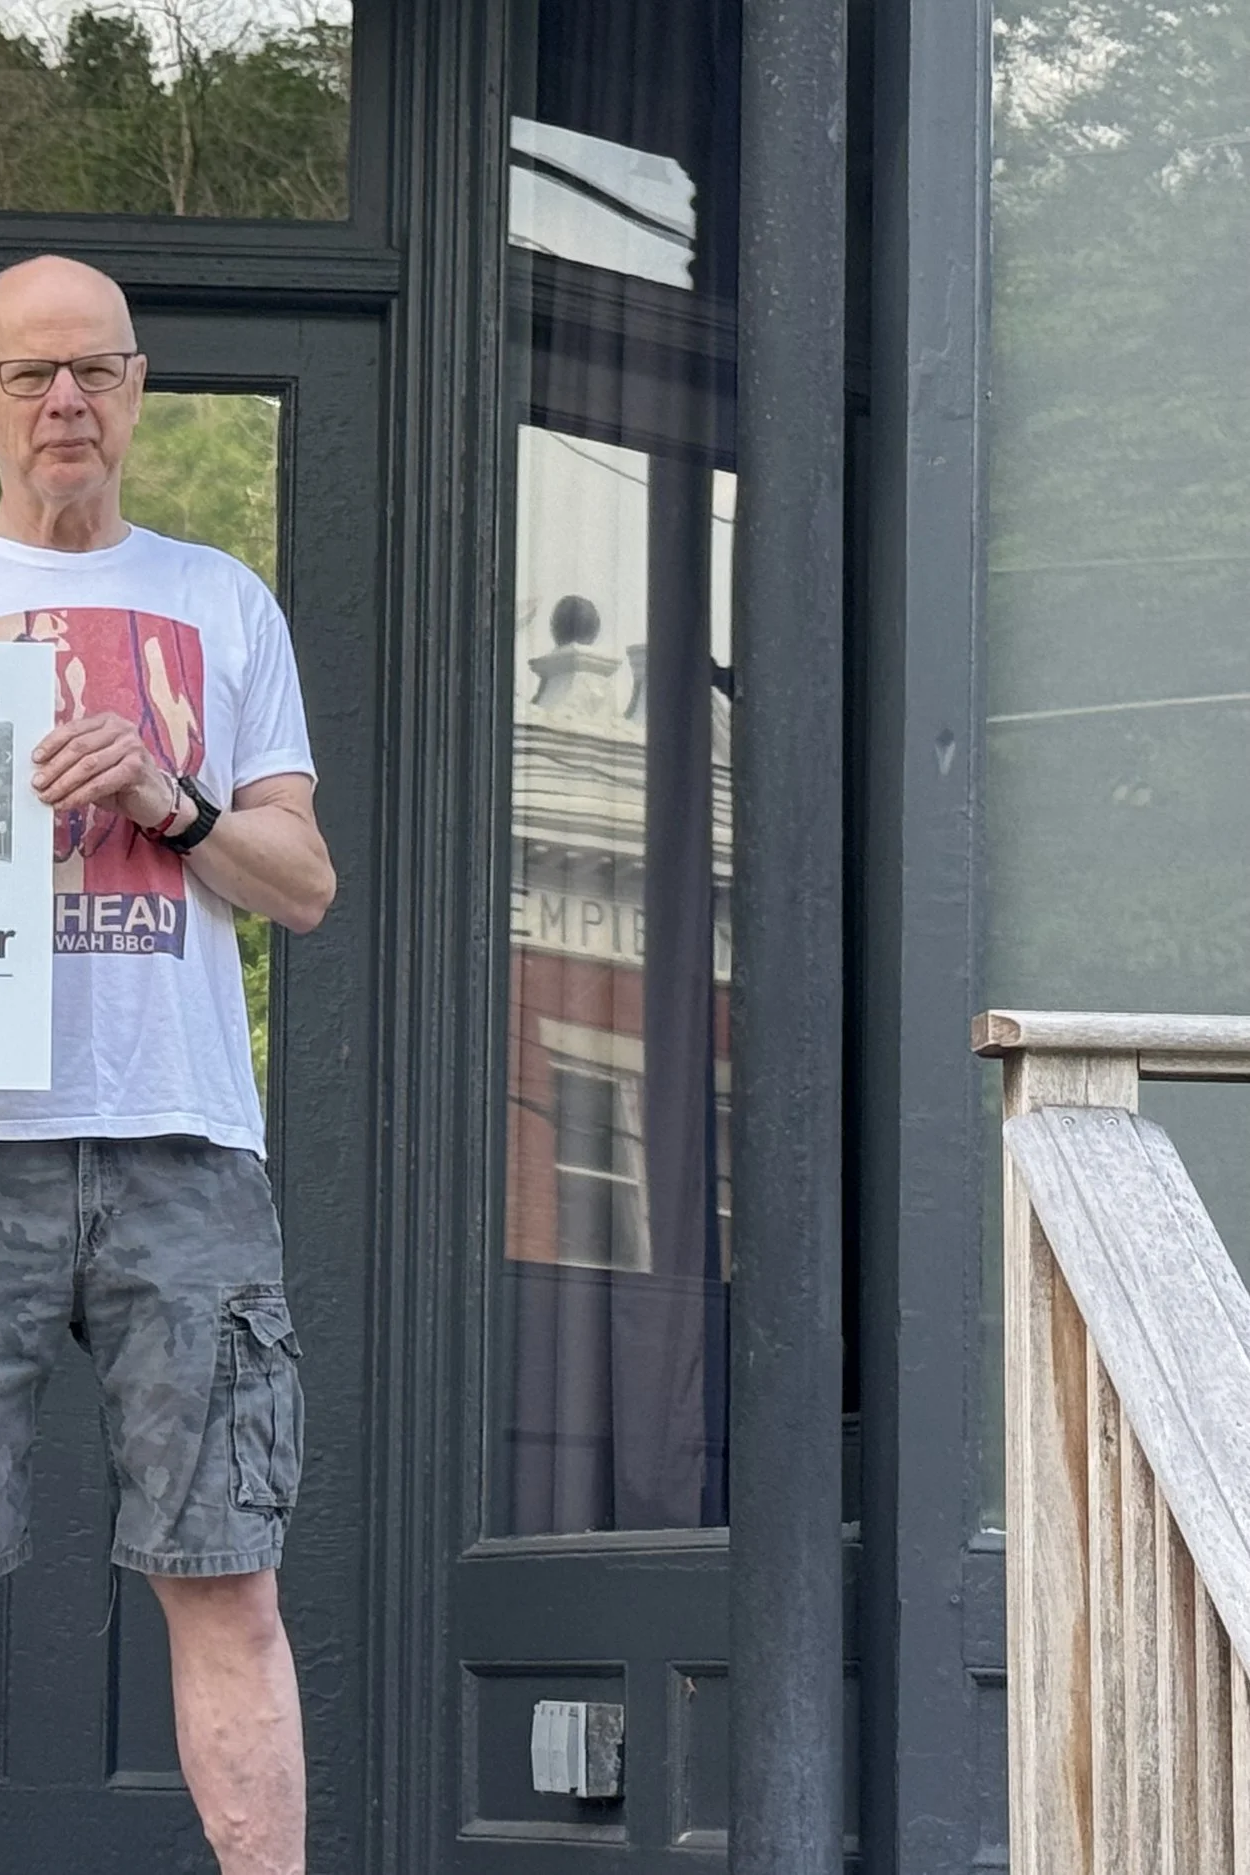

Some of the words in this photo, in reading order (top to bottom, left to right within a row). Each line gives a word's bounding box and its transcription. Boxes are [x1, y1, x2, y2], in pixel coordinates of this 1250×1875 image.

[56, 894, 177, 935] HEAD
[55, 934, 105, 951] WAH
[112, 934, 155, 951] BBQ
